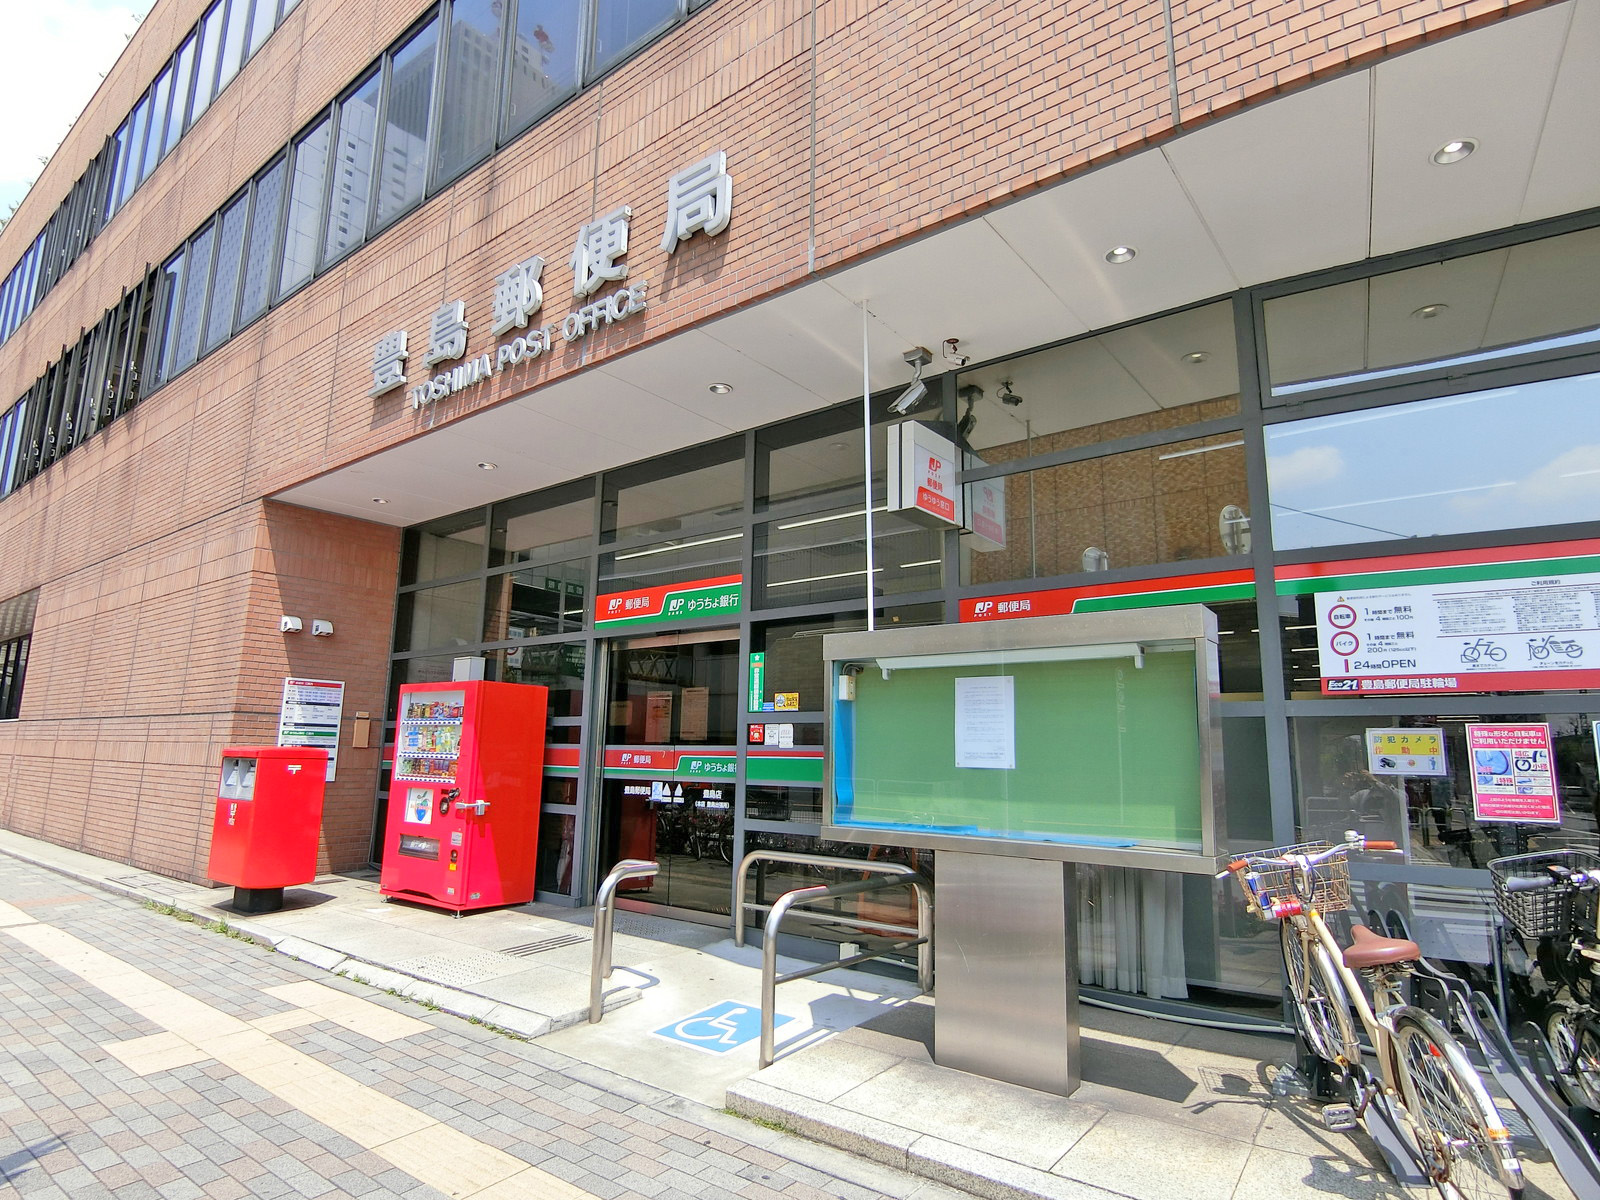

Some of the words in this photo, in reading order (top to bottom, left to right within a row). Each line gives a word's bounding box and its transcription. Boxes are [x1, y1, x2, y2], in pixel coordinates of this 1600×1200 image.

[368, 150, 733, 398] 豊島郵便局
[411, 354, 492, 410] TOSHIMA
[497, 323, 556, 372] POST
[562, 280, 648, 342] OFFICE
[927, 478, 942, 492] 郵便局
[922, 493, 950, 511] ゆうゆう窓口
[625, 596, 650, 610] 郵便局
[688, 594, 738, 610] ゆうちょ銀行
[997, 600, 1031, 613] 郵便局
[1328, 679, 1358, 690] Eco21
[1361, 677, 1457, 690] 豊島郵便局駐輪場
[1373, 735, 1437, 744] 防犯カメラ
[1375, 746, 1438, 755] 作動中
[633, 755, 652, 764] 郵便局
